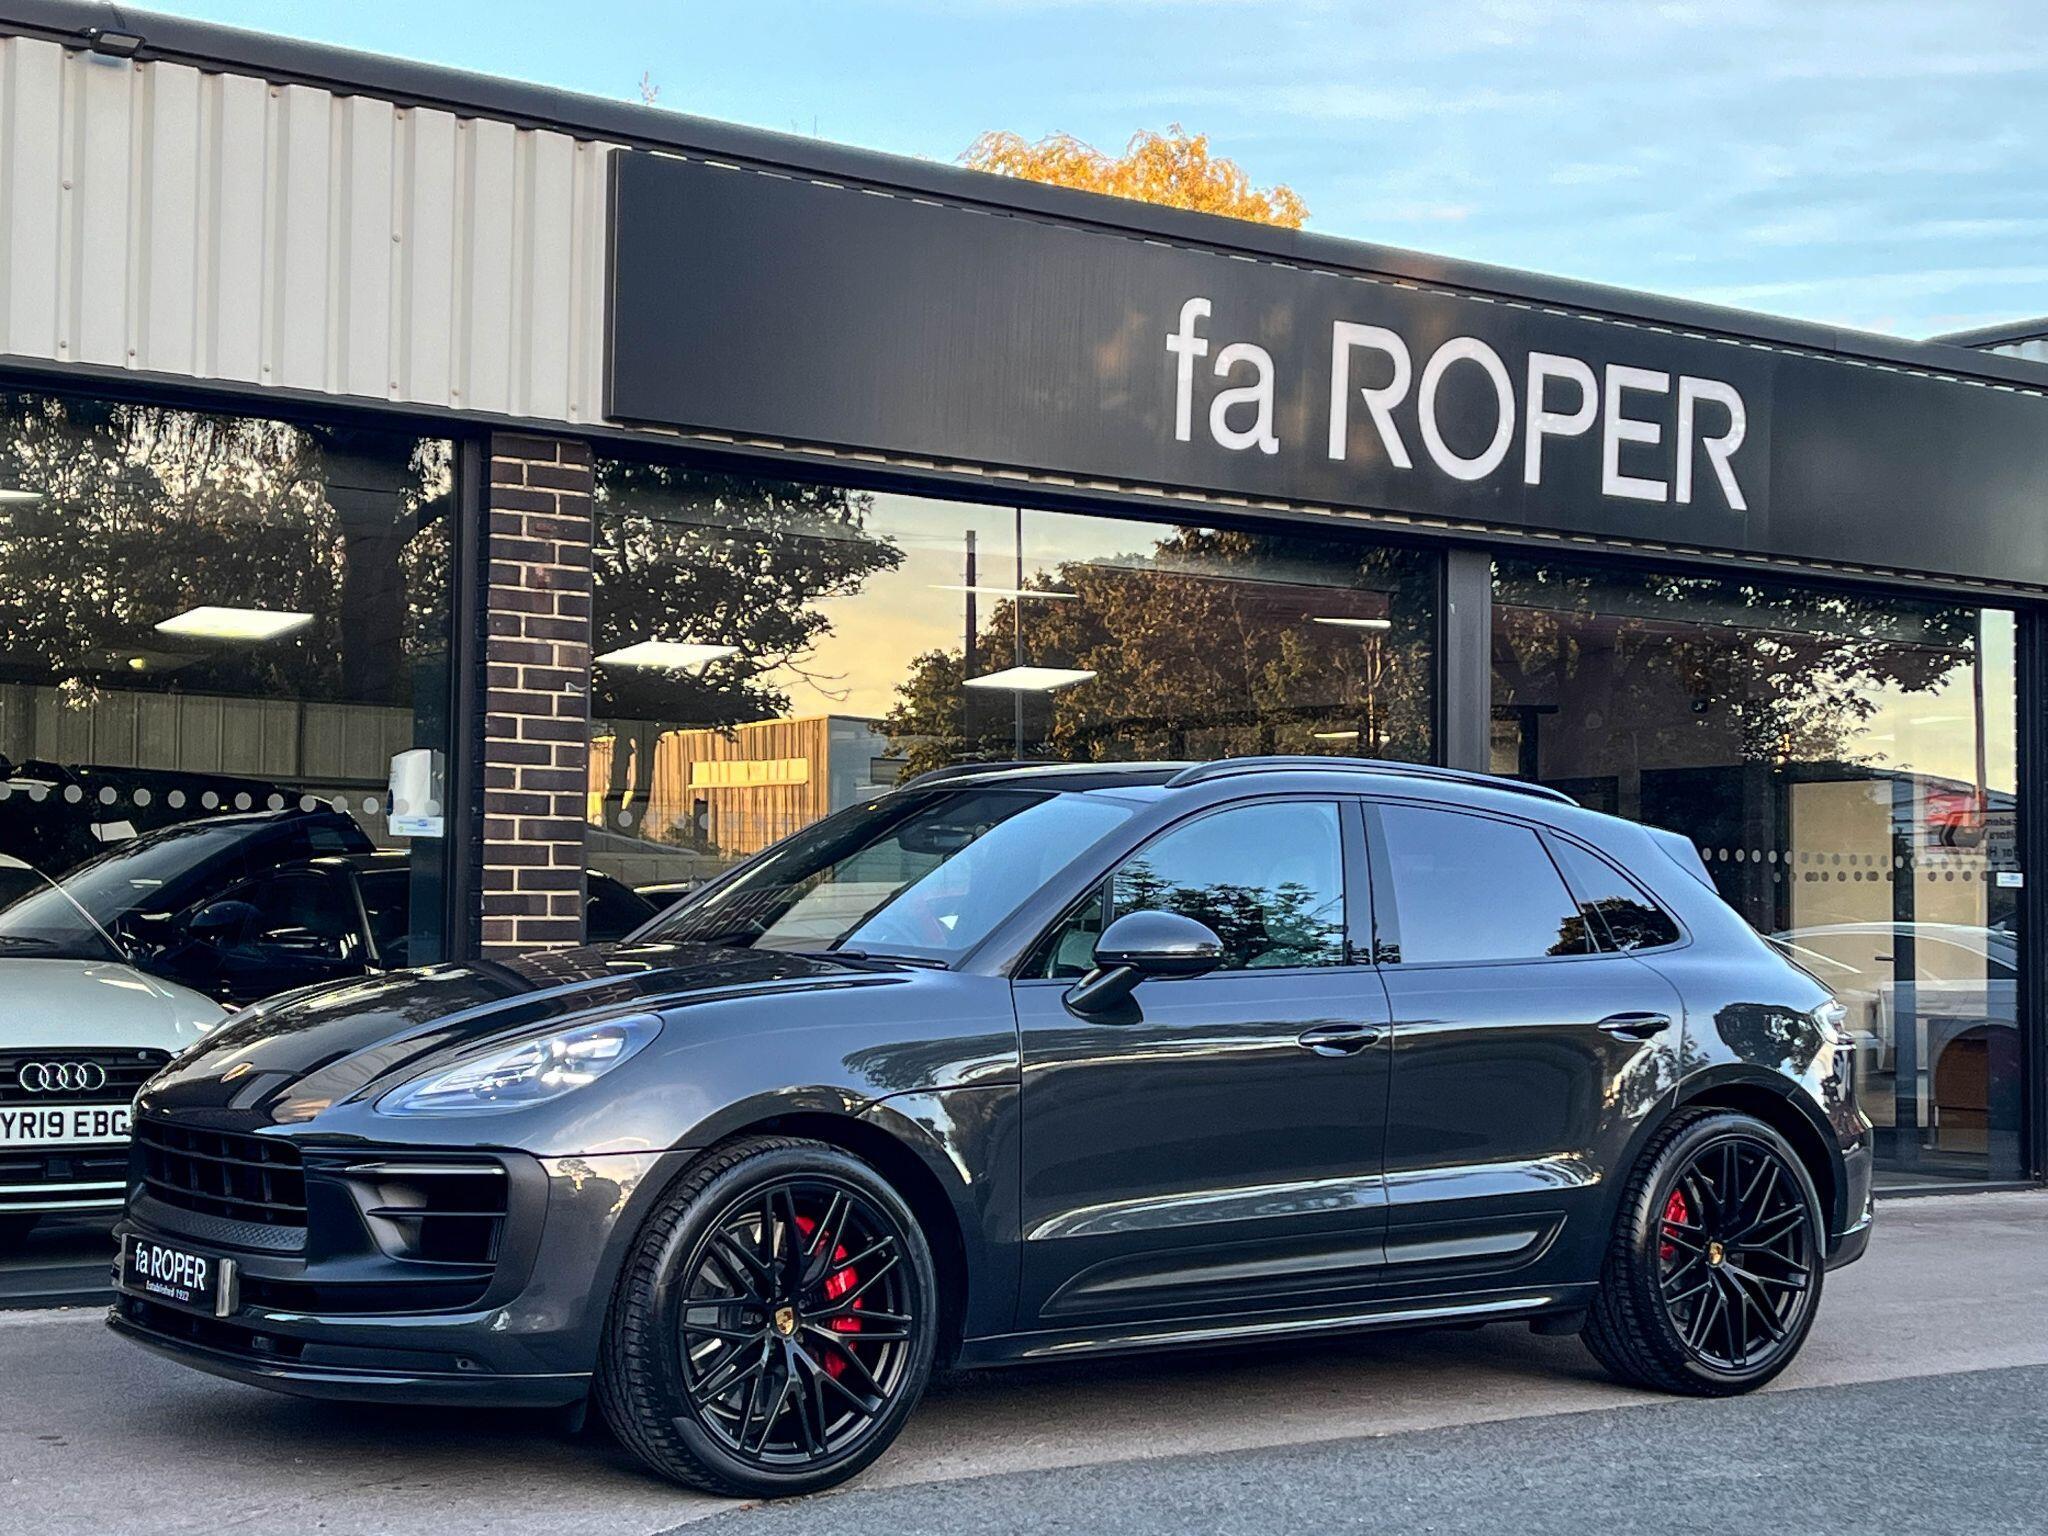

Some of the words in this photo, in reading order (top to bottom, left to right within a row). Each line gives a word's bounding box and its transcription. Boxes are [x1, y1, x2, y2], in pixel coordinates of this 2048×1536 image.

[1166, 297, 1279, 455] fa
[1328, 320, 1747, 511] ROPER
[0, 1111, 64, 1139] YR19
[74, 1110, 129, 1137] EBG
[135, 1242, 148, 1274] fa
[151, 1245, 206, 1291] ROPER
